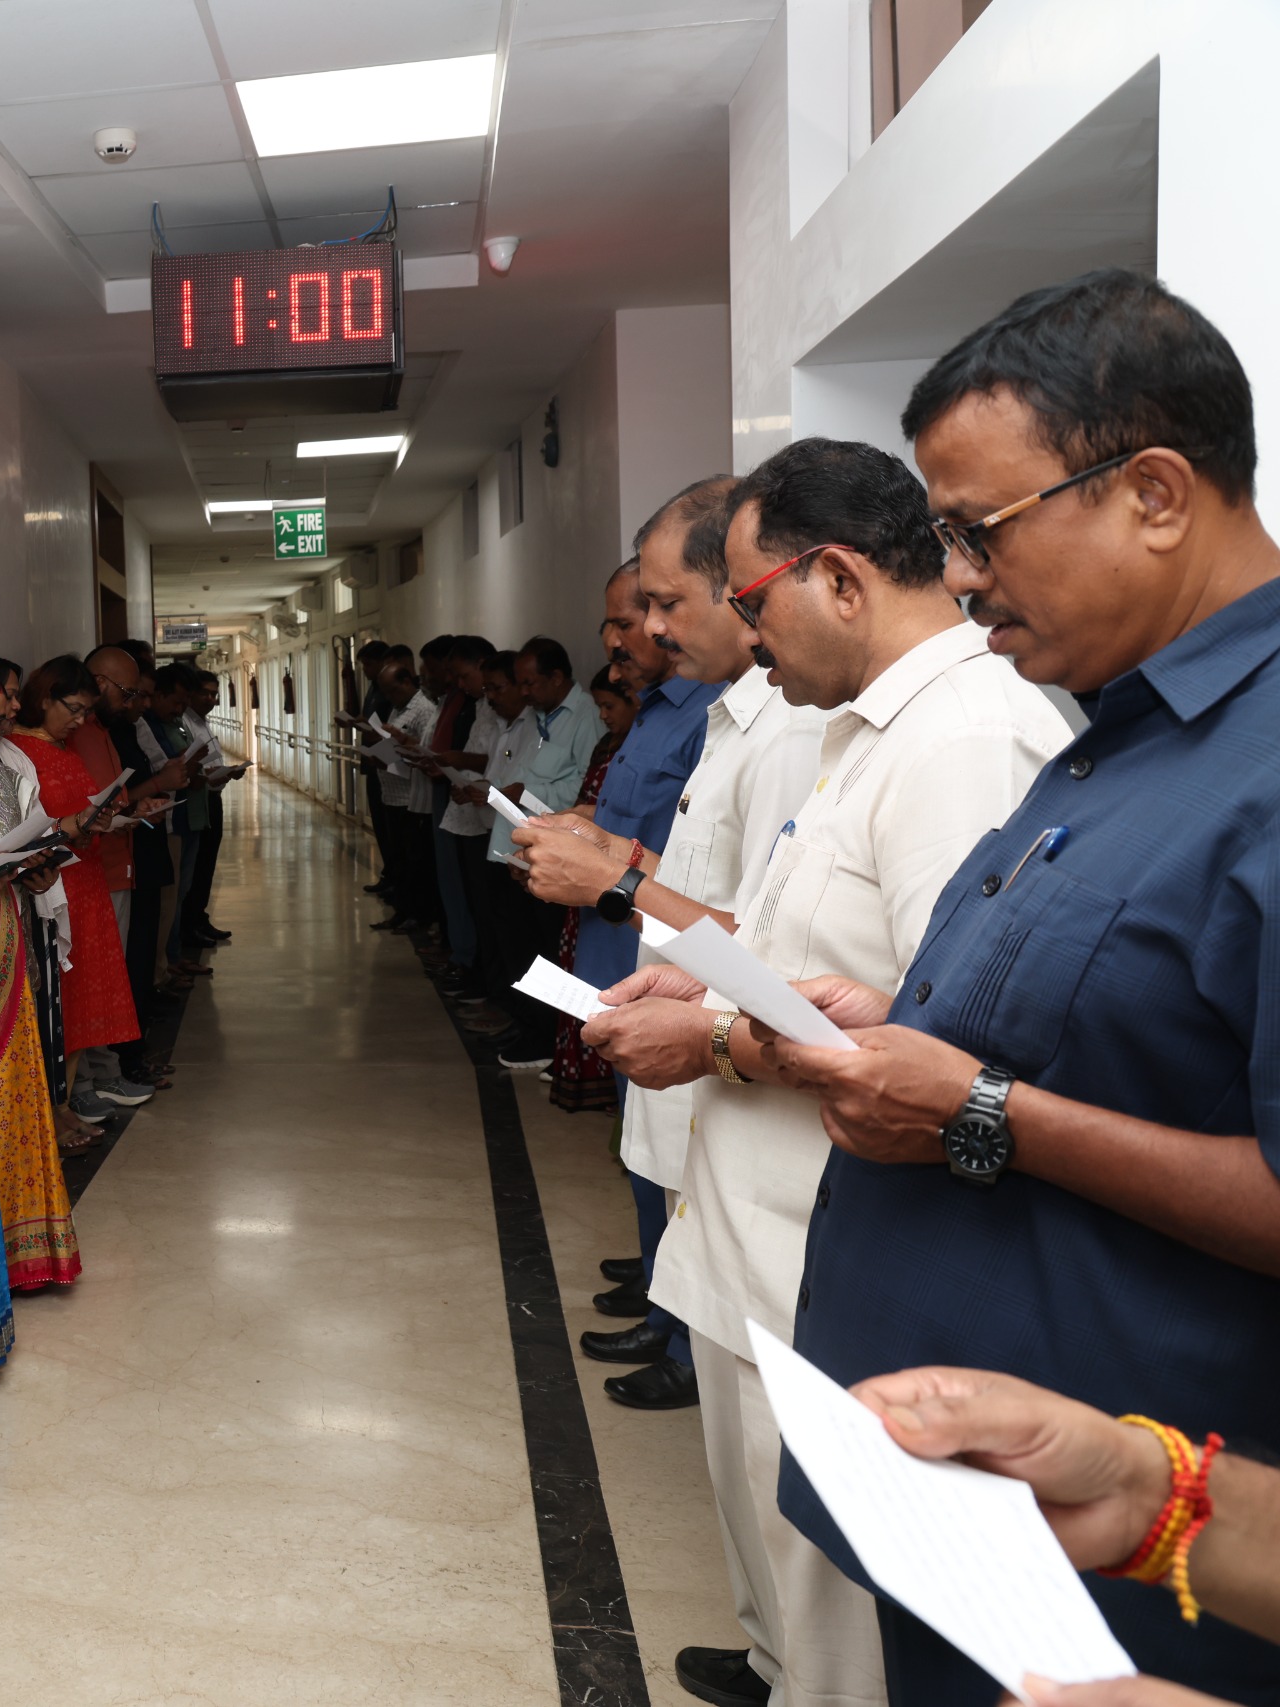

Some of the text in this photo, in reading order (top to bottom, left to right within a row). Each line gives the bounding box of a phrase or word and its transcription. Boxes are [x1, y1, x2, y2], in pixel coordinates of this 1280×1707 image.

[182, 268, 382, 349] 11:00
[297, 513, 323, 532] FIRE
[297, 535, 323, 554] EXIT
